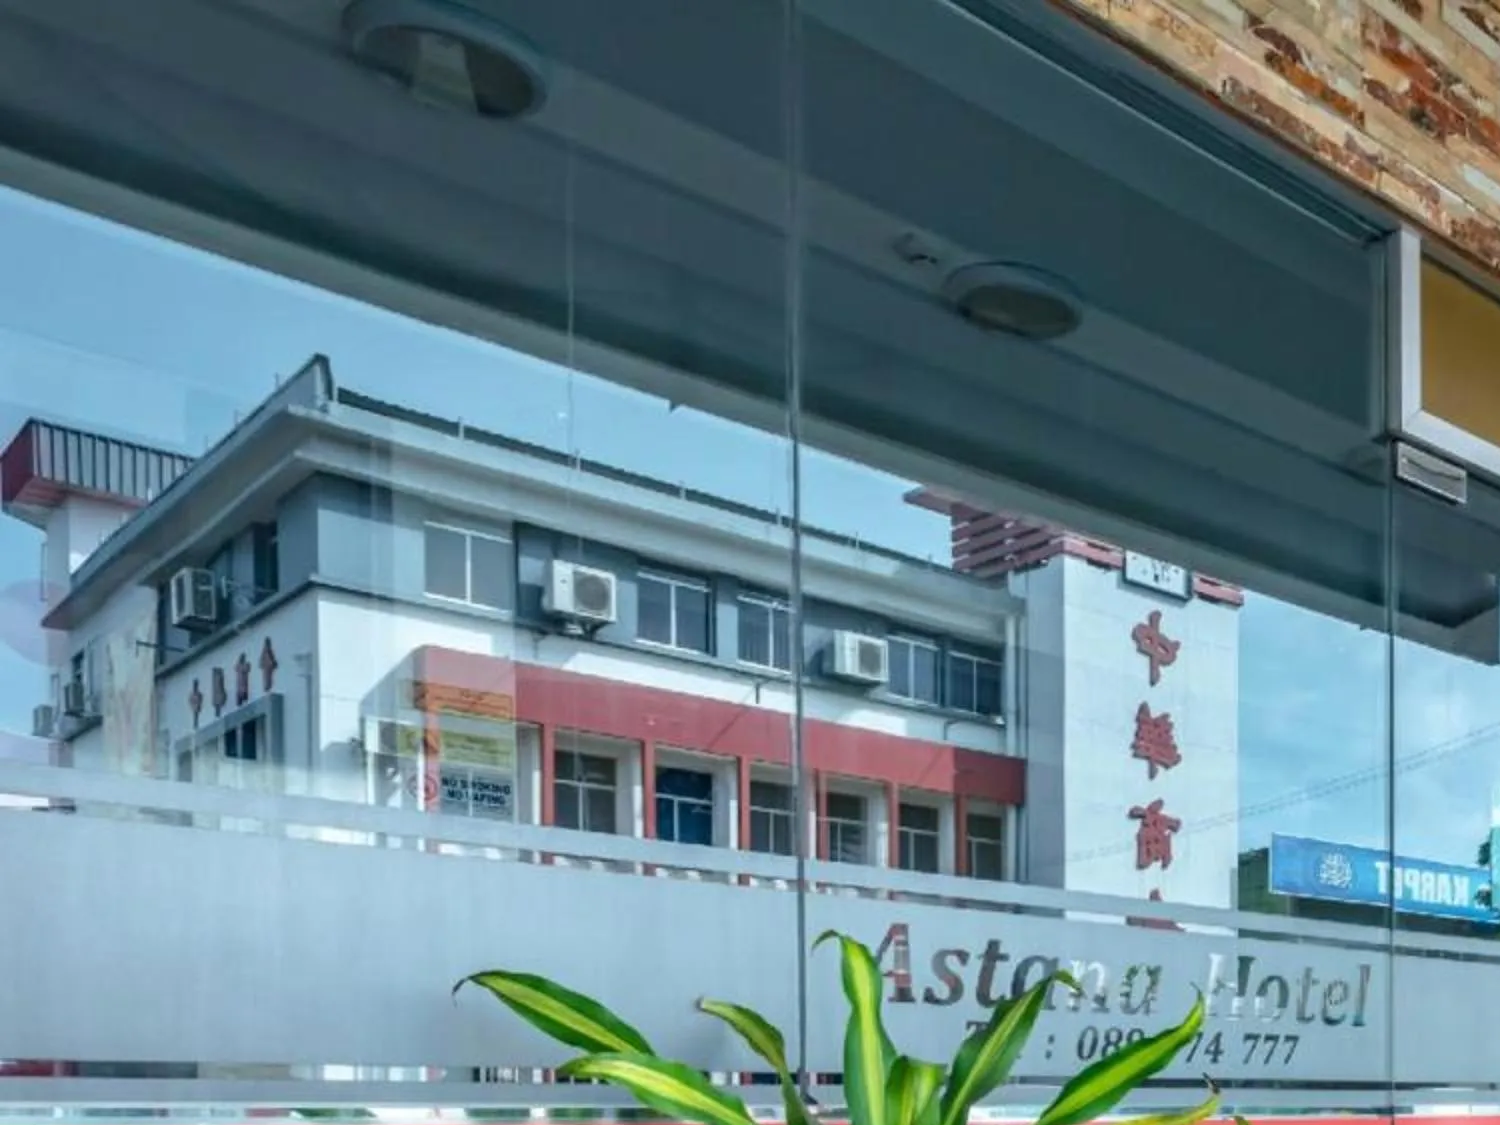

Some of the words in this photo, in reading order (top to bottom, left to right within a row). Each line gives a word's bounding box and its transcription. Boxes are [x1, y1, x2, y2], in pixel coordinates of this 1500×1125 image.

[876, 922, 1163, 1016] Astana
[1202, 951, 1371, 1028] Hotel
[1242, 1032, 1300, 1065] 777
